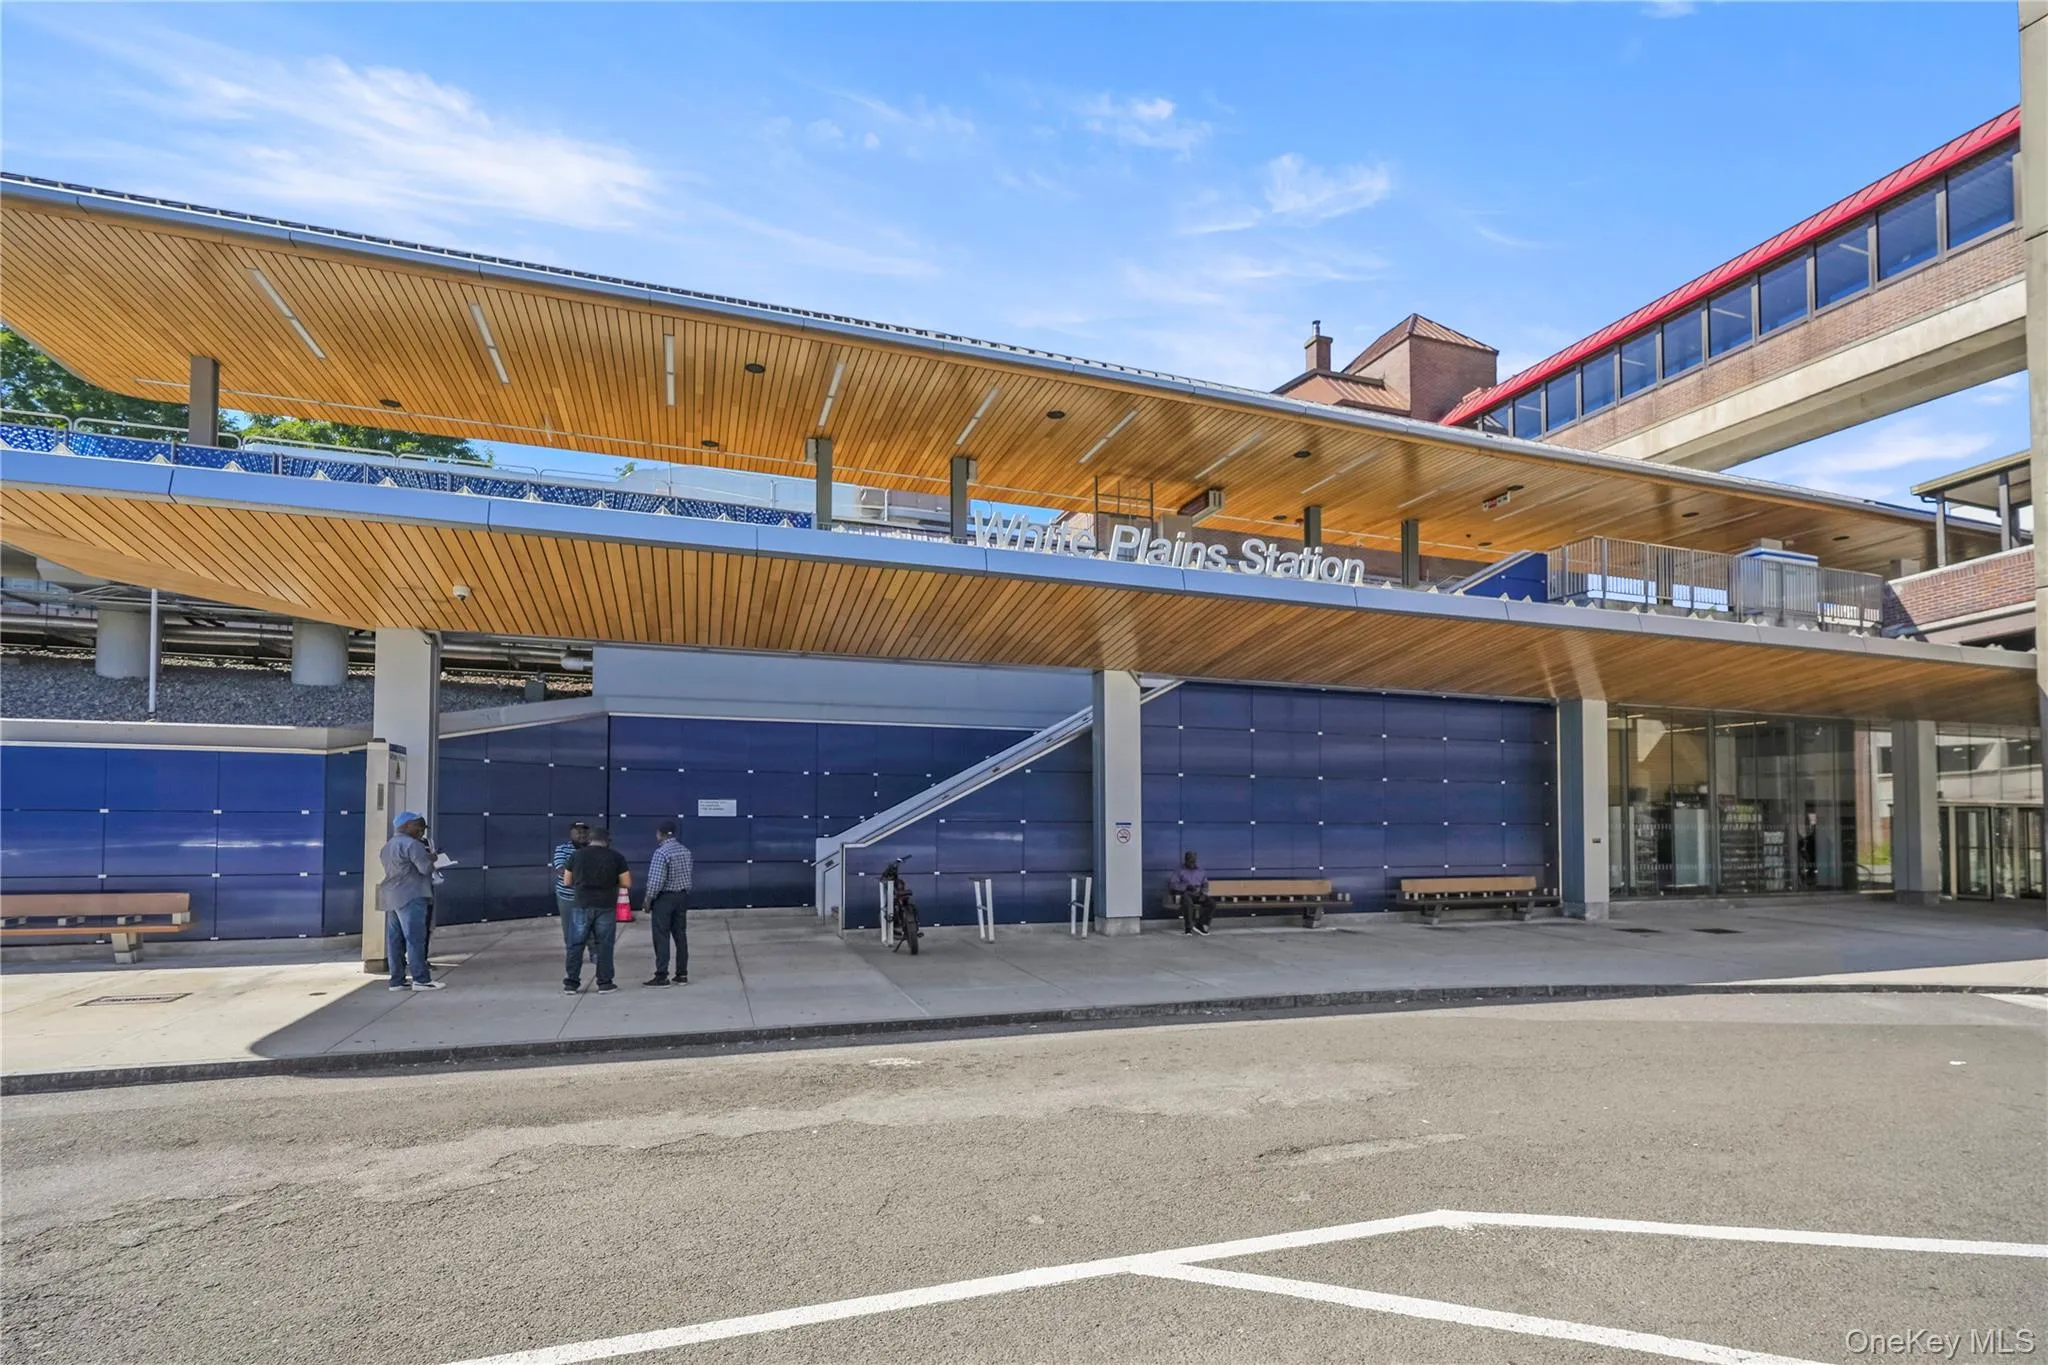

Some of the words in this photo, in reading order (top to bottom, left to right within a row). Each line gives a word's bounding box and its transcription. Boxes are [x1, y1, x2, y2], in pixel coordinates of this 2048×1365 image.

[975, 509, 1096, 556] White
[1109, 524, 1228, 570] Plains
[1239, 538, 1365, 586] Station
